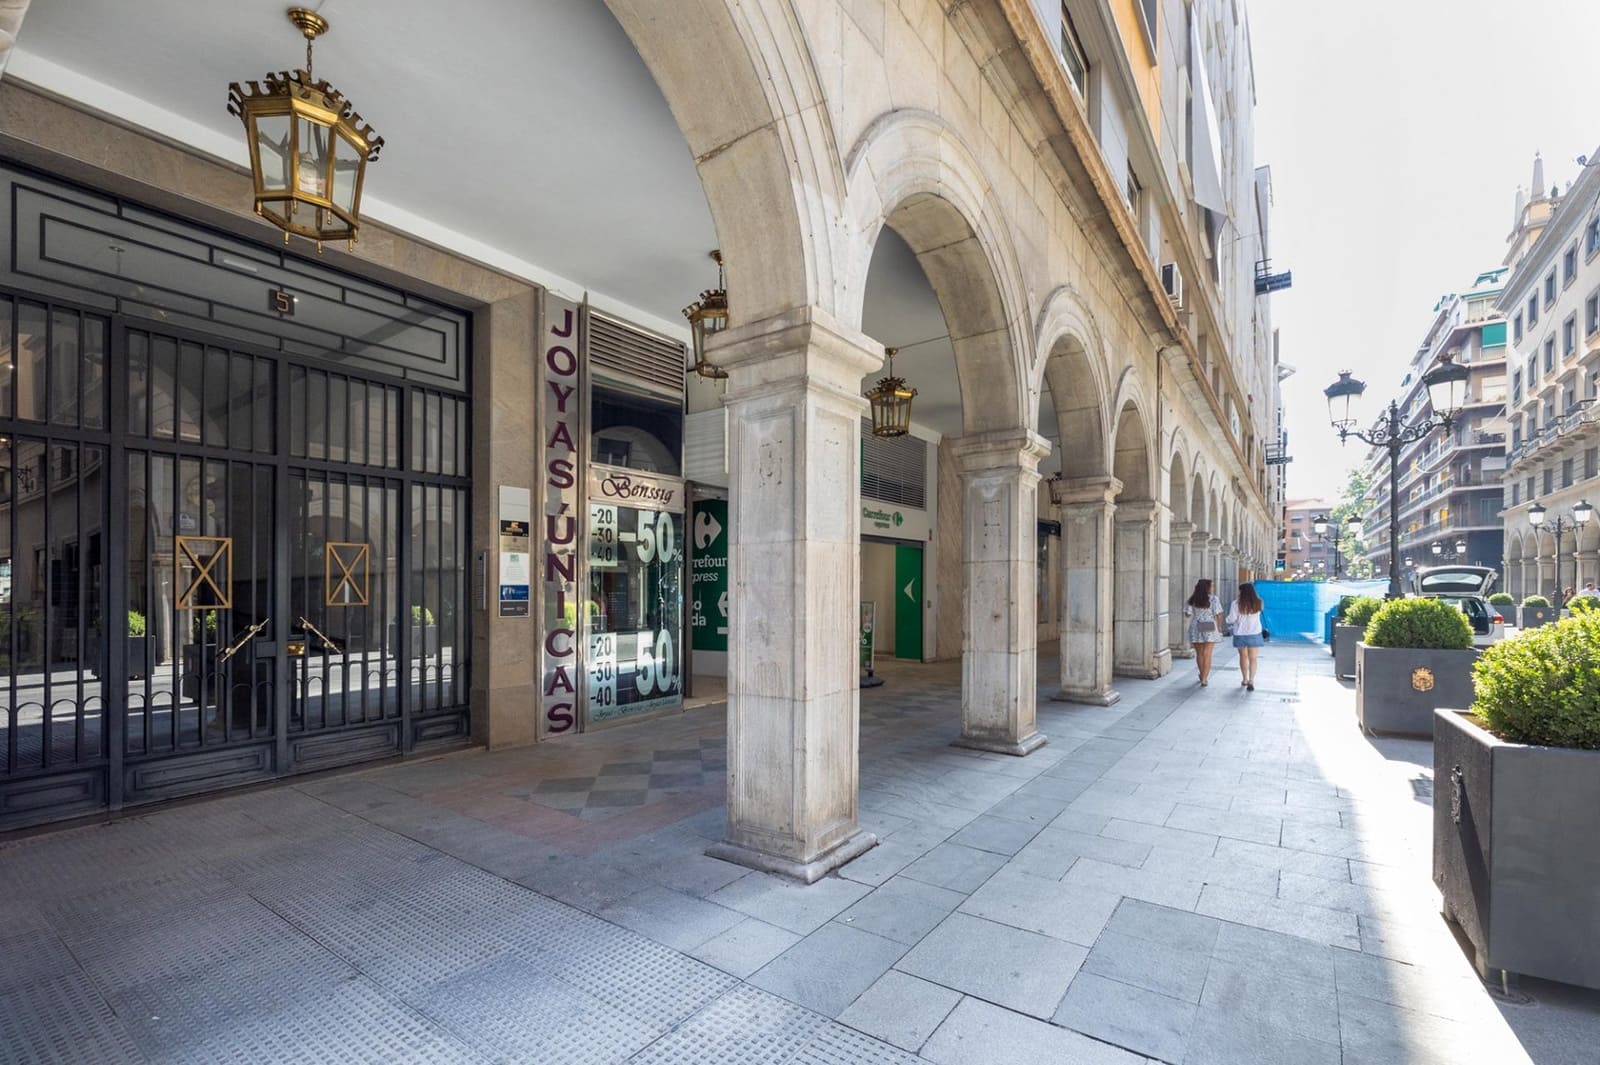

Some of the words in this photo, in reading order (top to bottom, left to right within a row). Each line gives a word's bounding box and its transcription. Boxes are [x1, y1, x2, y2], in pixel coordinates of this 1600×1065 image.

[276, 291, 289, 312] 5
[546, 308, 577, 489] JOYAS
[692, 554, 728, 568] refour
[692, 572, 718, 584] press
[545, 503, 575, 733] ÚNICAS
